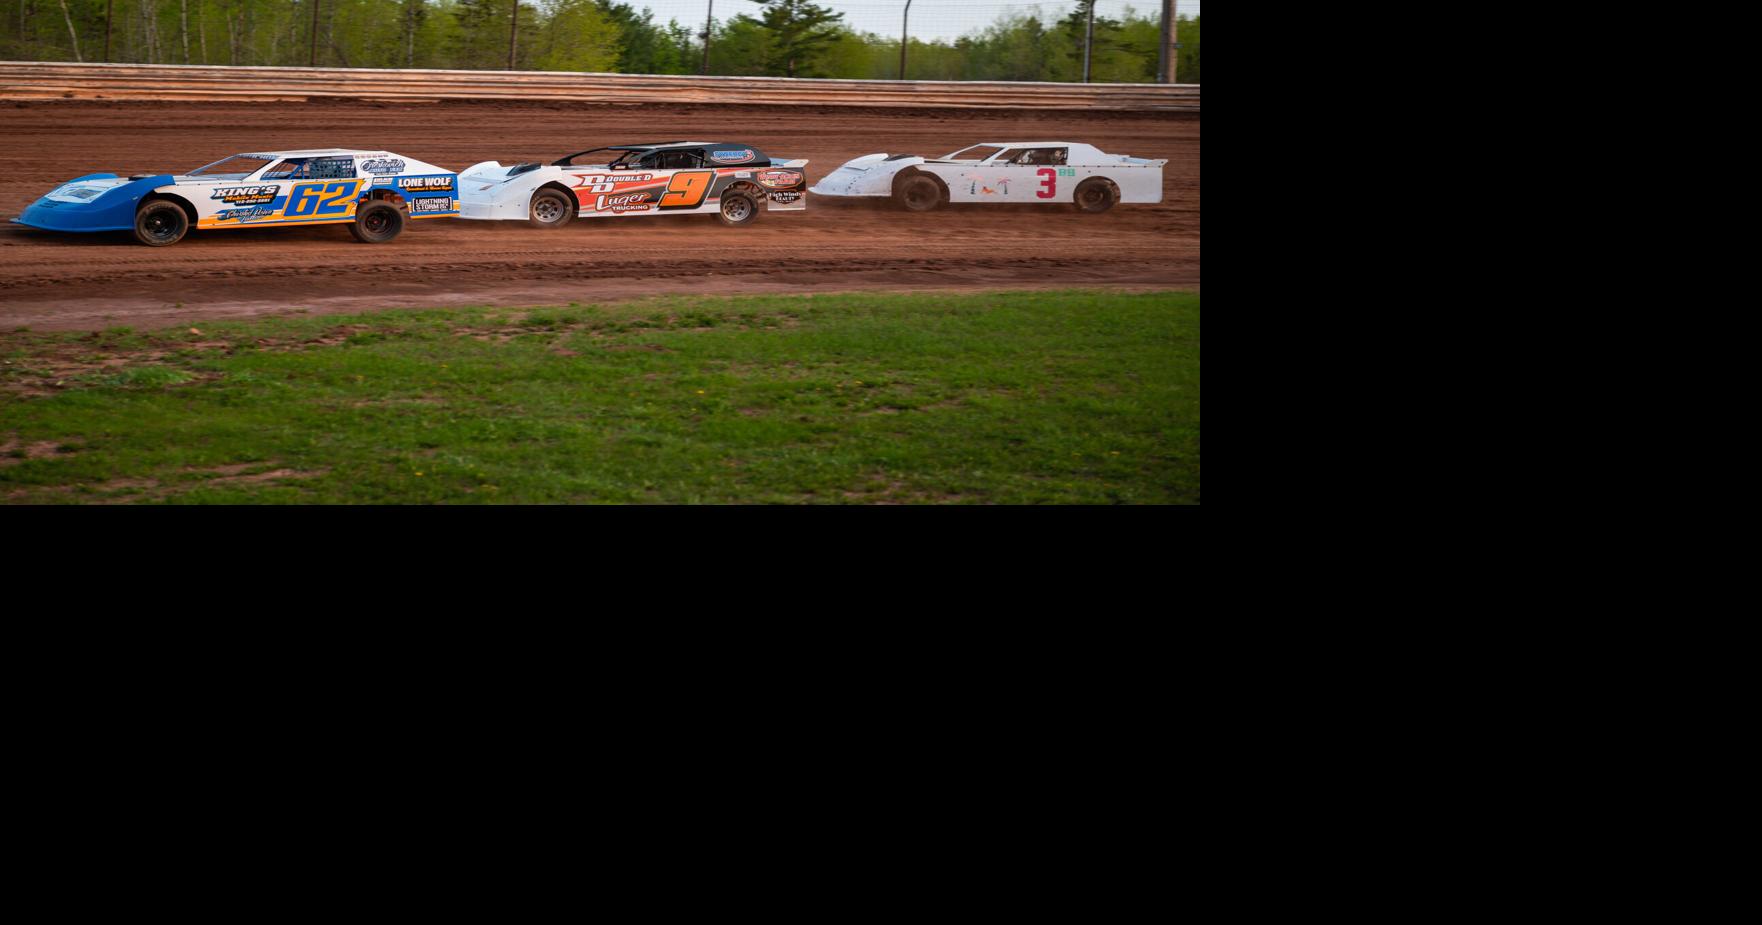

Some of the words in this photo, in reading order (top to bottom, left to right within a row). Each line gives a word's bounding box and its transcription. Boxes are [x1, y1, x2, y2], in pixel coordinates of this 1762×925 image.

[398, 178, 425, 188] LONE
[425, 177, 452, 187] WOLF
[606, 175, 642, 183] DOUBLE
[1036, 168, 1057, 199] 3
[214, 185, 277, 197] KING'S
[659, 171, 713, 207] 9
[283, 180, 361, 217] 62
[596, 193, 647, 211] Luger
